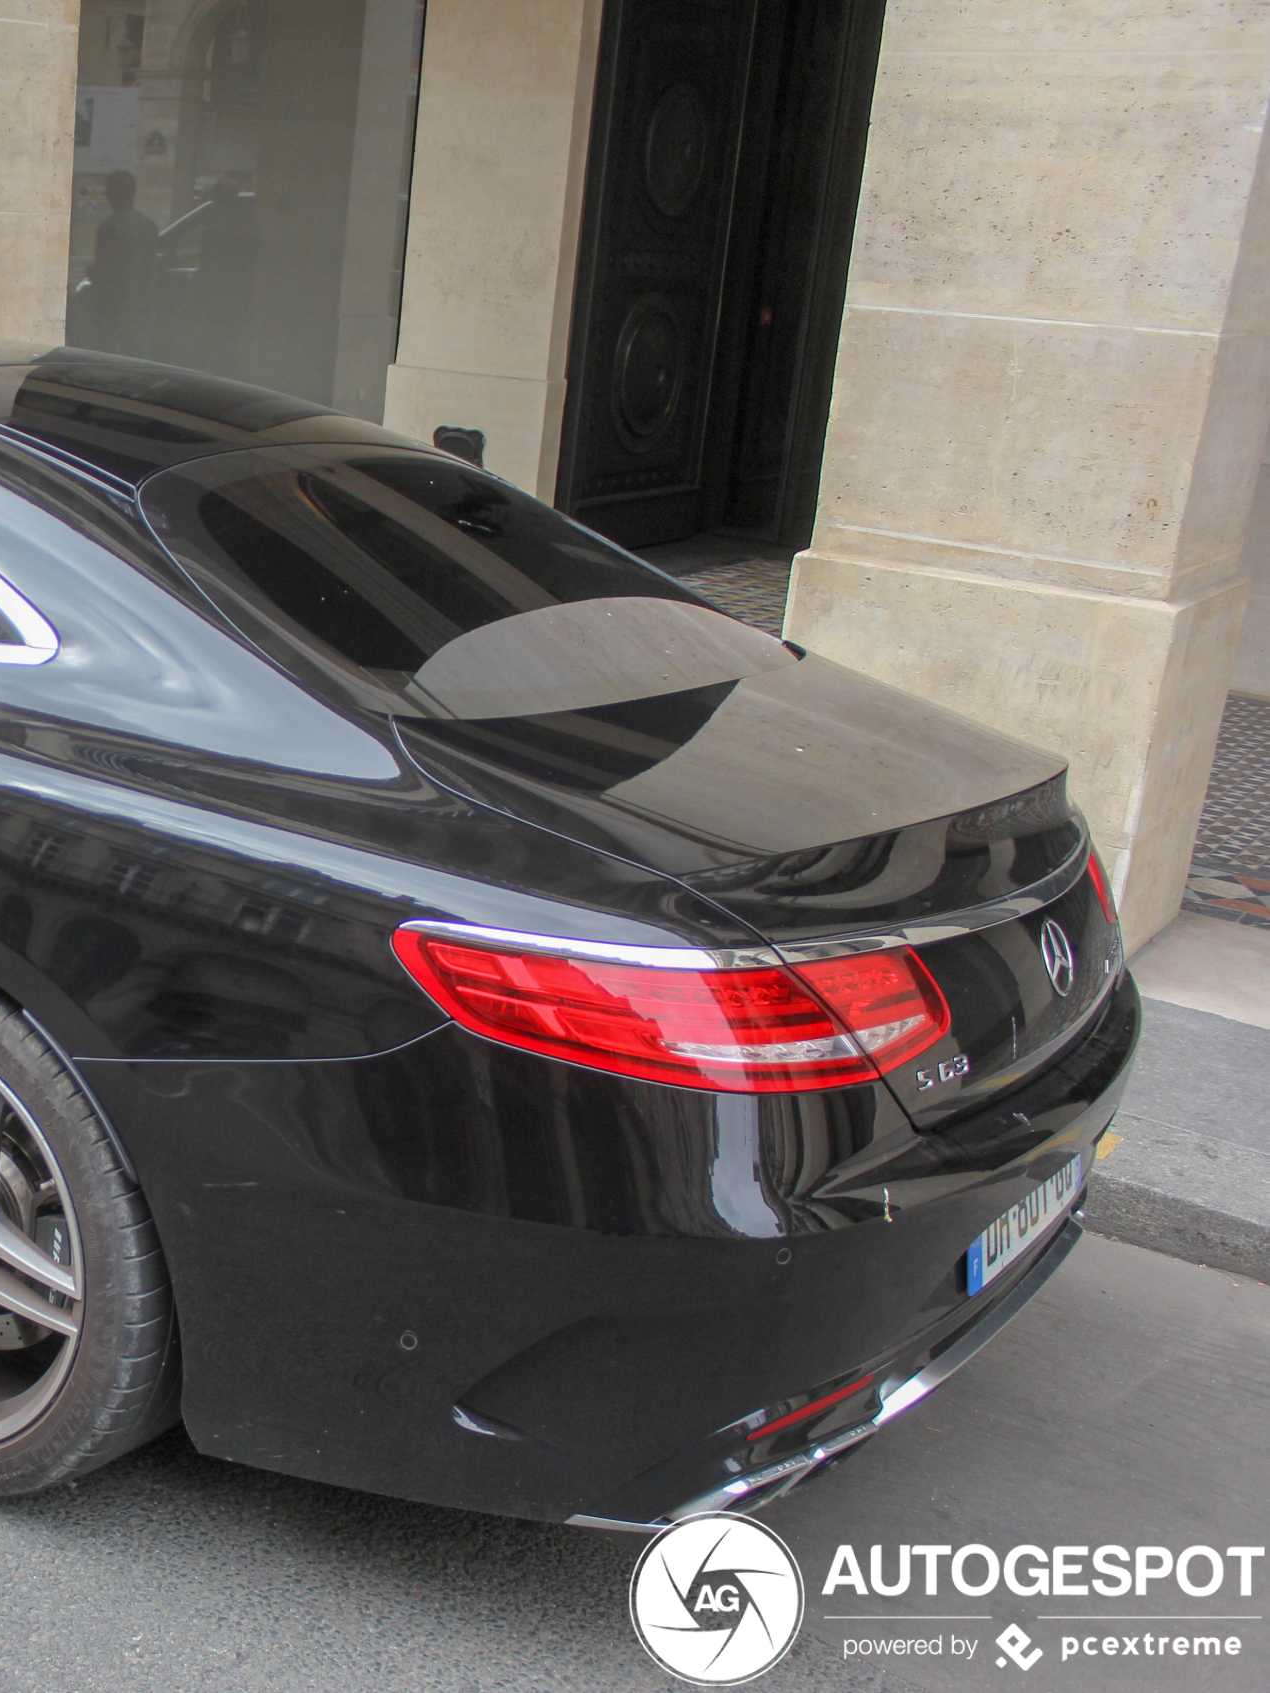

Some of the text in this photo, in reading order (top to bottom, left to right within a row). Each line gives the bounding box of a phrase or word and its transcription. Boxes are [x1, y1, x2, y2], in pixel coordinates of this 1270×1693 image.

[916, 1053, 970, 1091] S 63
[973, 1258, 979, 1277] F
